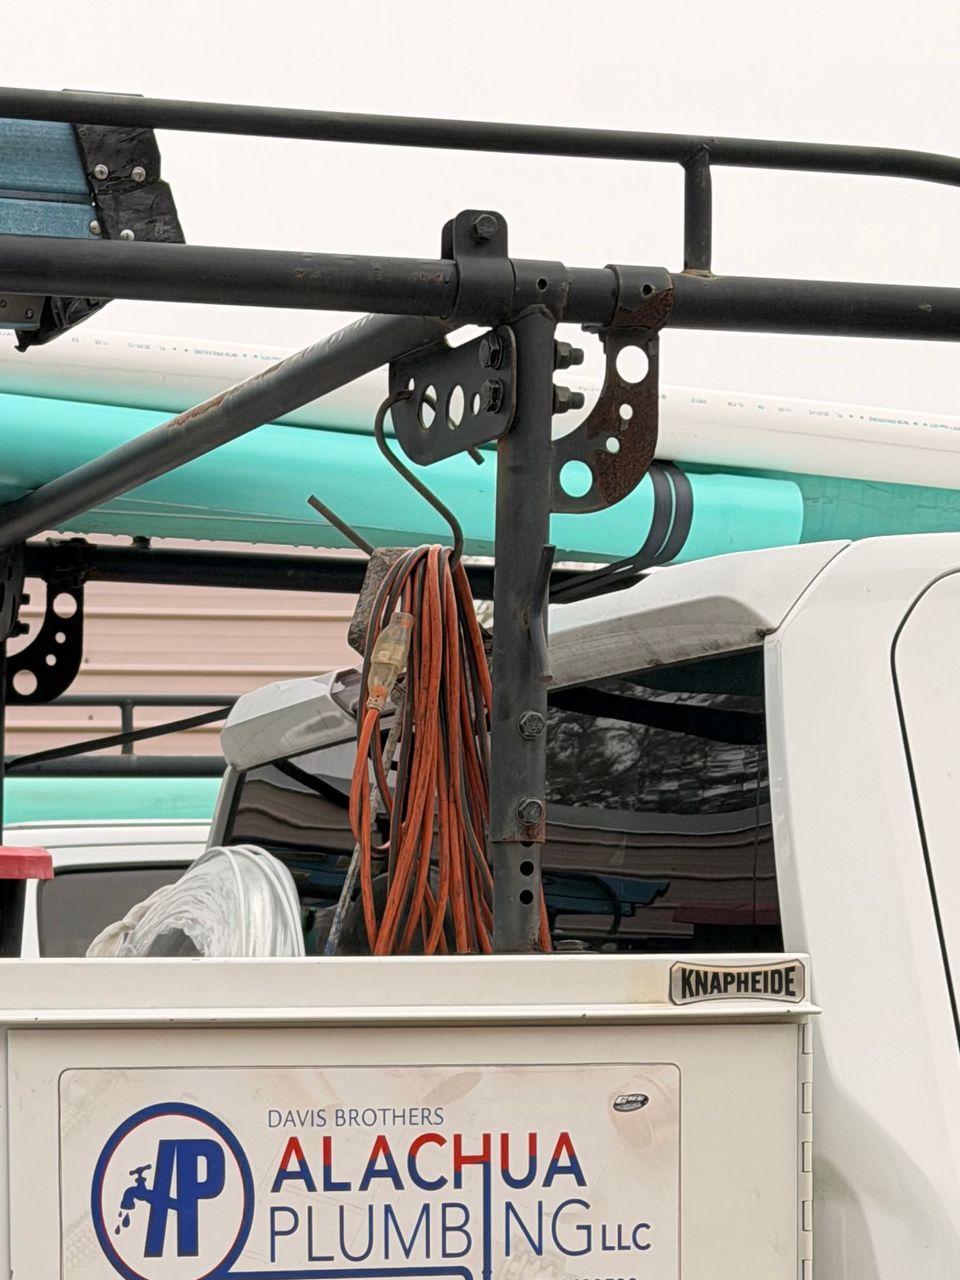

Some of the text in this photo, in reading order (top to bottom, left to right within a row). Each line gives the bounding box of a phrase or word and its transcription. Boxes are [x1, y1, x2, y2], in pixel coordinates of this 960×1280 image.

[681, 966, 797, 999] KNAPHEIDE
[268, 1107, 445, 1128] DAVIS BROTHERS
[270, 1131, 588, 1193] ALACHUA
[270, 1199, 652, 1263] PLUMBING LLC
